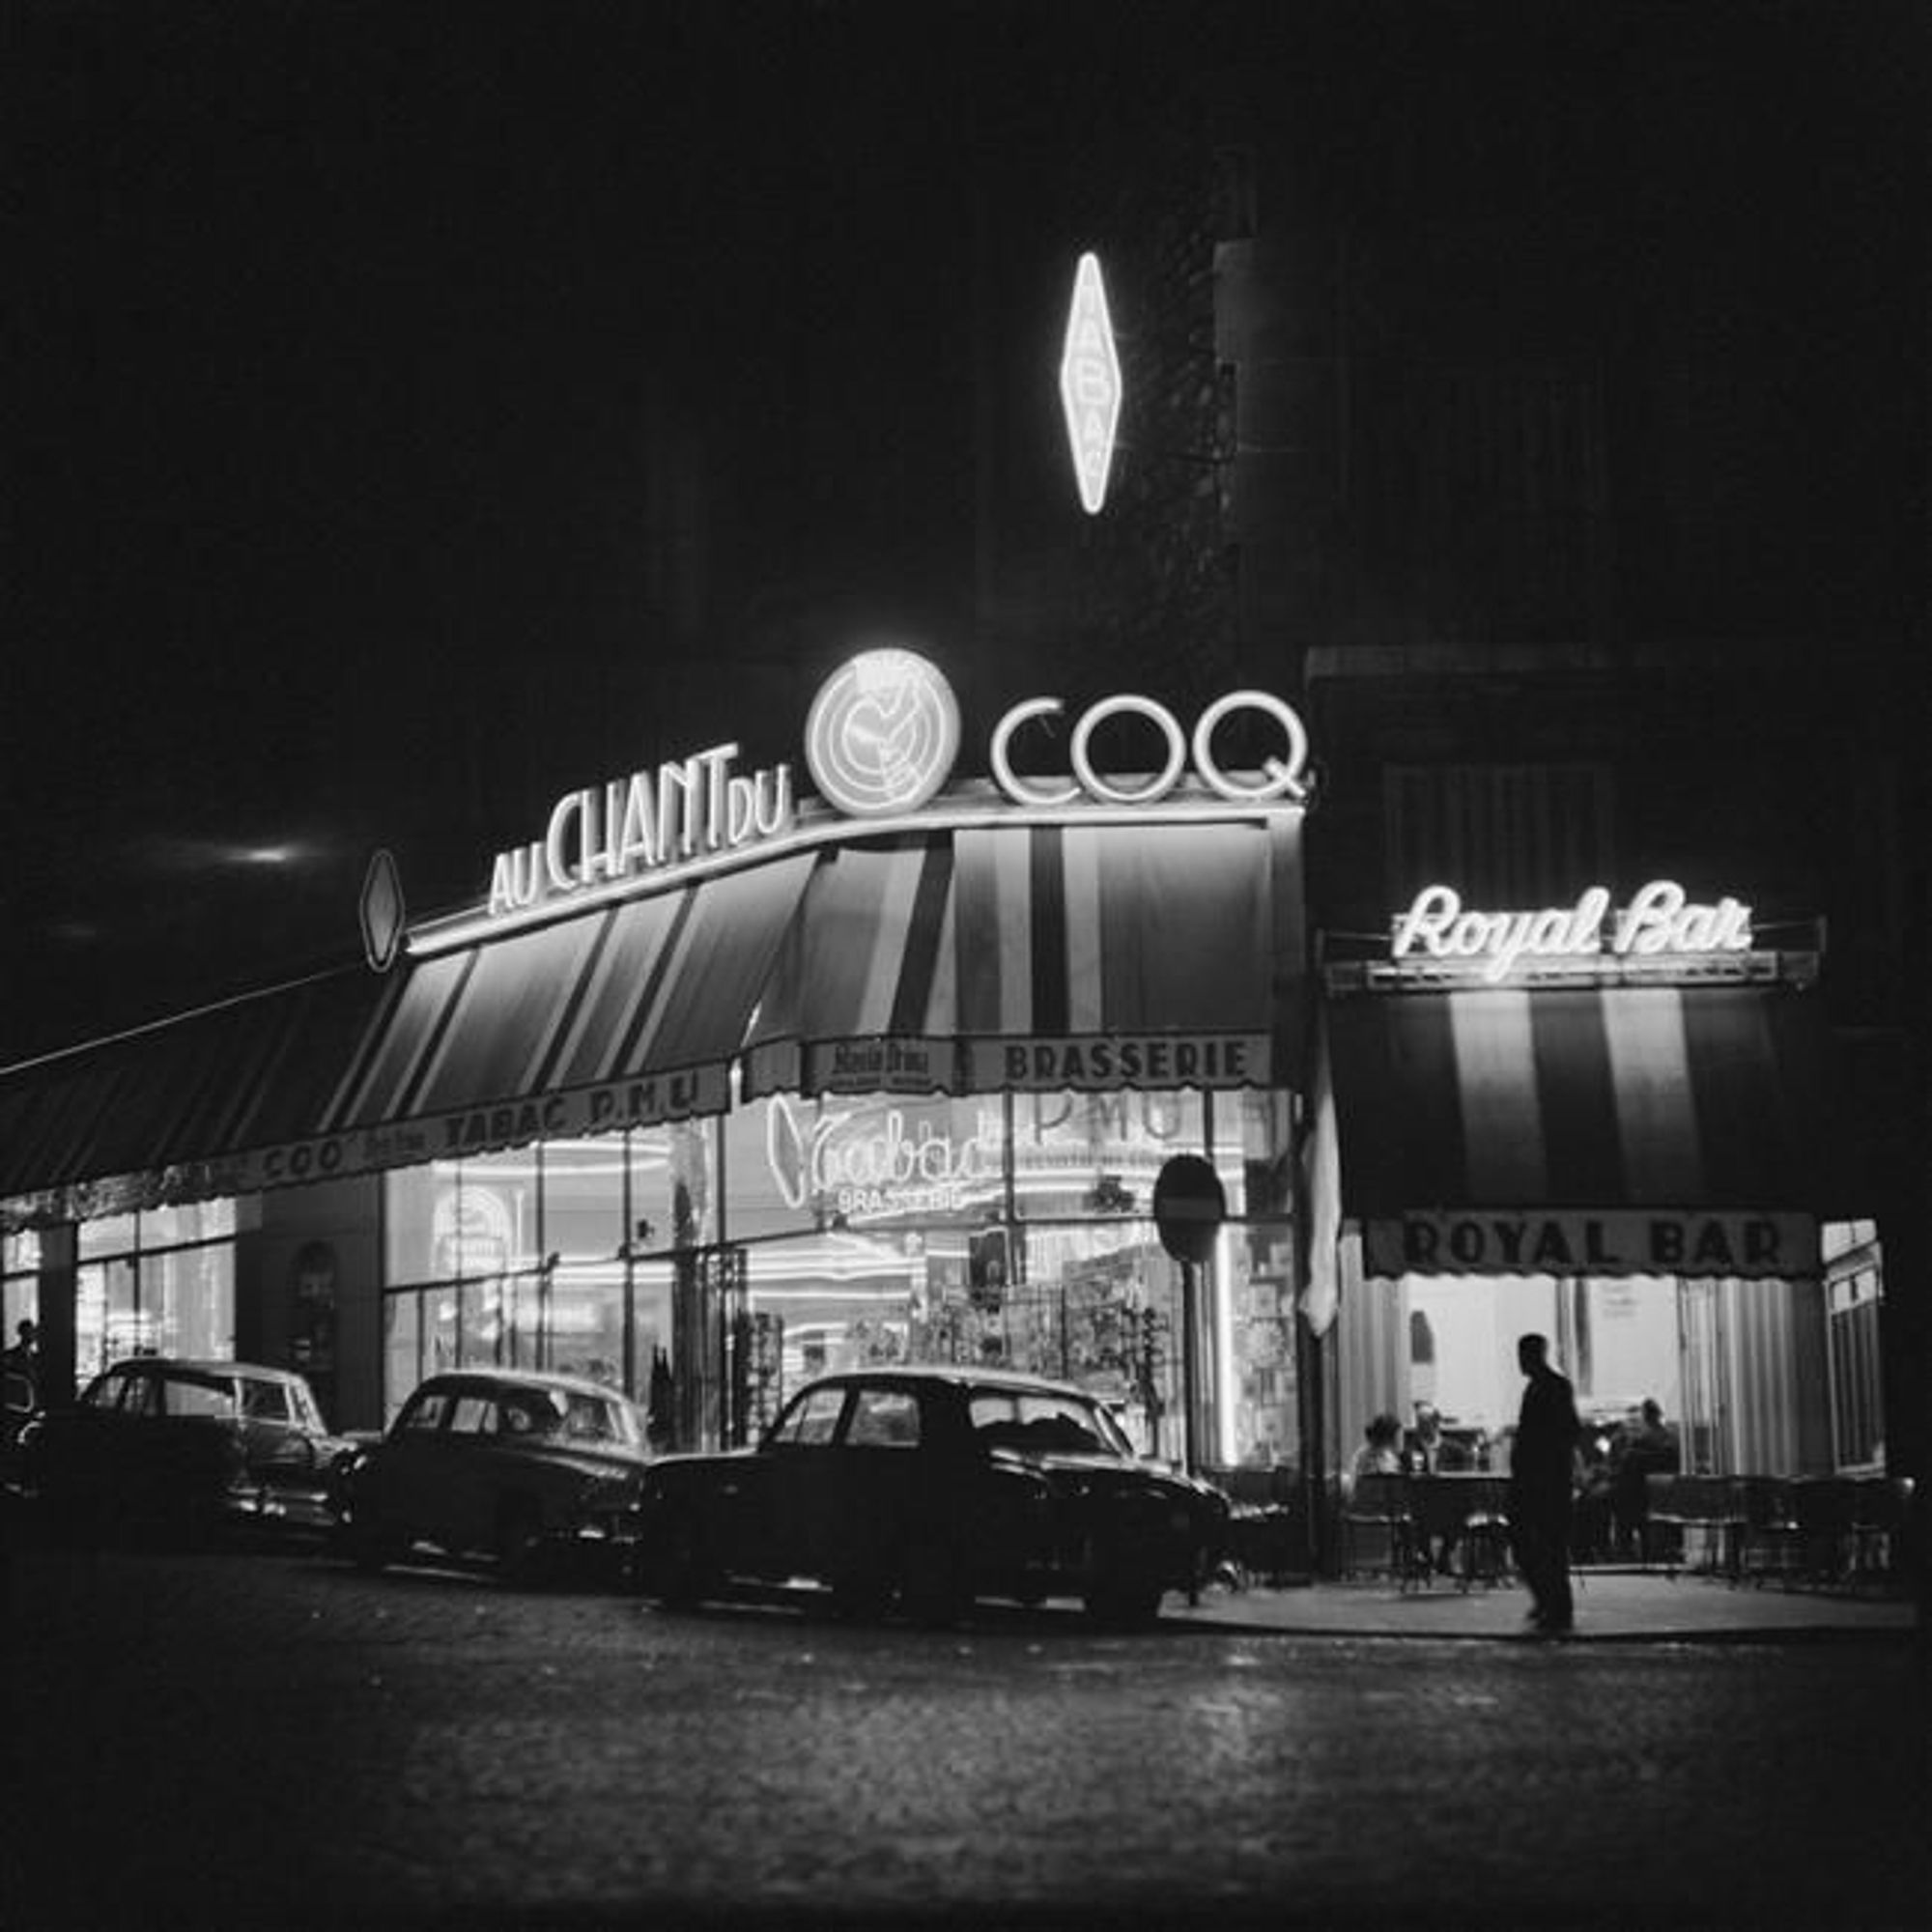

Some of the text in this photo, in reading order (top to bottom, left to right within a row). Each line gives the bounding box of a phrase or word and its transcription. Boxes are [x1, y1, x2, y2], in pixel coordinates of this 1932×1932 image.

[488, 690, 1310, 915] AU CHANT DU COQ
[1391, 880, 1753, 983] Royal Bar
[1006, 1043, 1246, 1080] BRASSERIE
[444, 1096, 568, 1150] TABAC
[1403, 1221, 1781, 1264] ROYAL BAR
